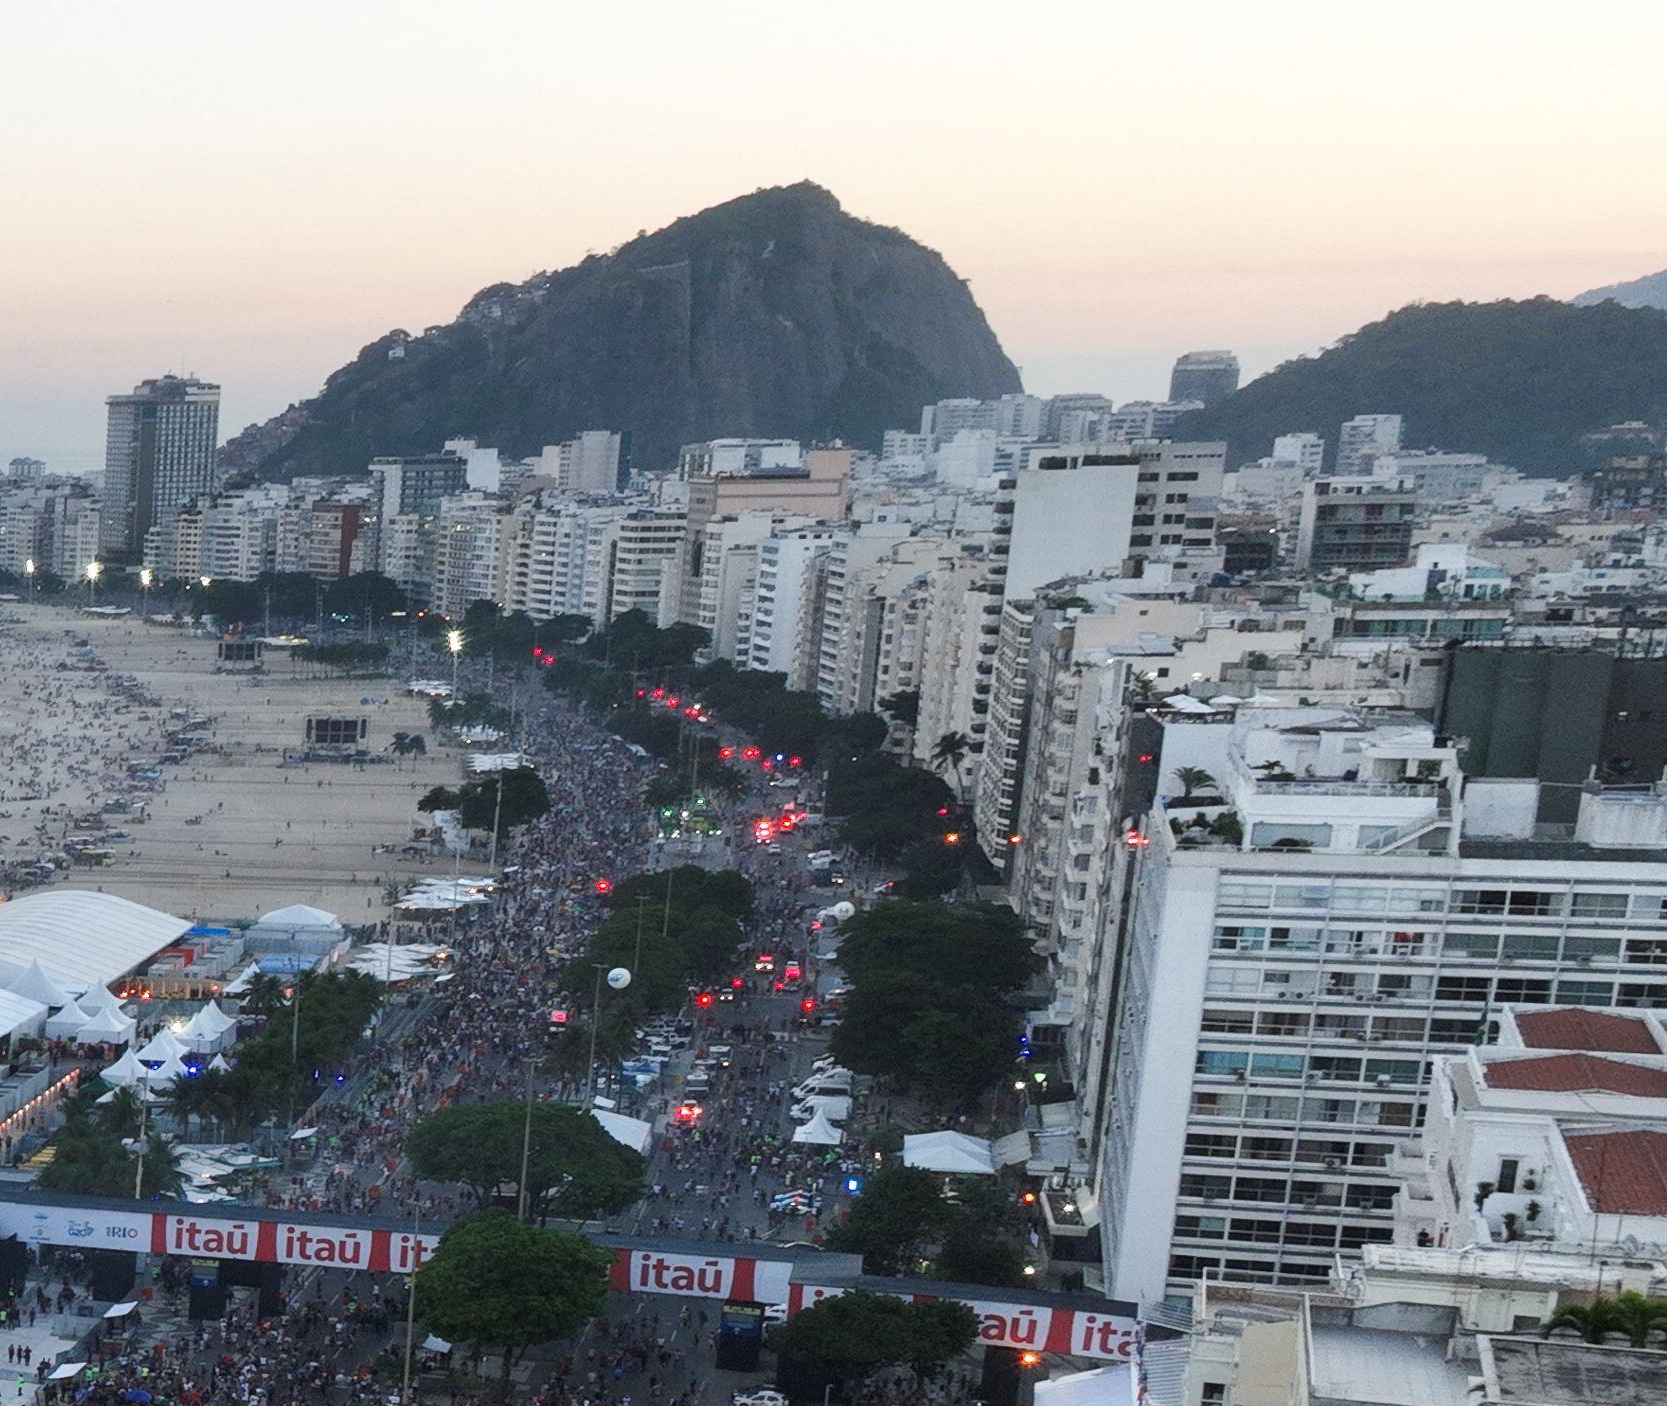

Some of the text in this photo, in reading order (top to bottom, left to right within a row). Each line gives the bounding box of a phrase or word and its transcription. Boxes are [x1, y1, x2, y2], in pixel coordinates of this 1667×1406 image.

[175, 1218, 248, 1255] itaú
[285, 1226, 361, 1264] itaú
[639, 1253, 723, 1294] itaú
